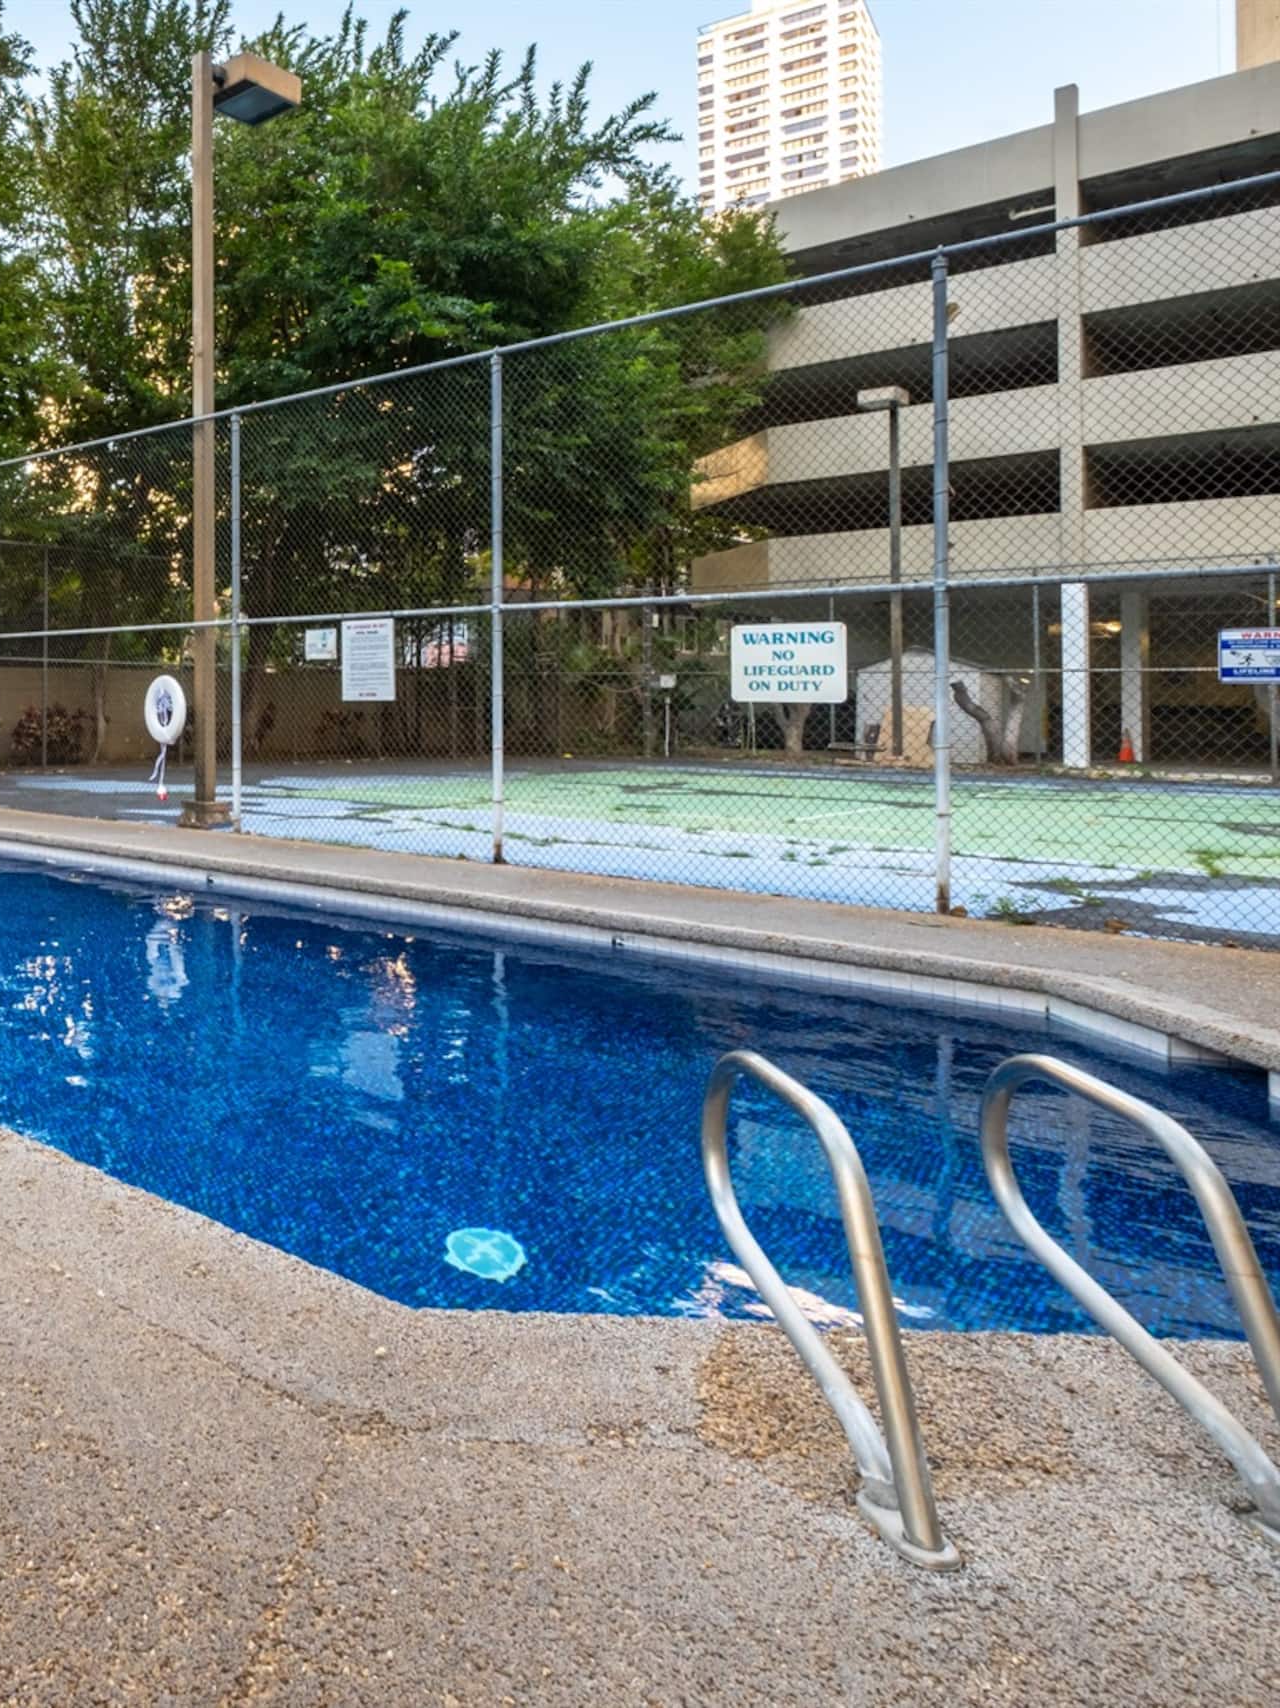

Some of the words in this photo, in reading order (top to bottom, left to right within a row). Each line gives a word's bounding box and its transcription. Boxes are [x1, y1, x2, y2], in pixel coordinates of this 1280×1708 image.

[742, 630, 835, 645] WARNING
[771, 649, 795, 661] NO
[743, 664, 835, 676] LIFEGUARD
[748, 681, 770, 692] ON
[777, 680, 823, 691] DUTY
